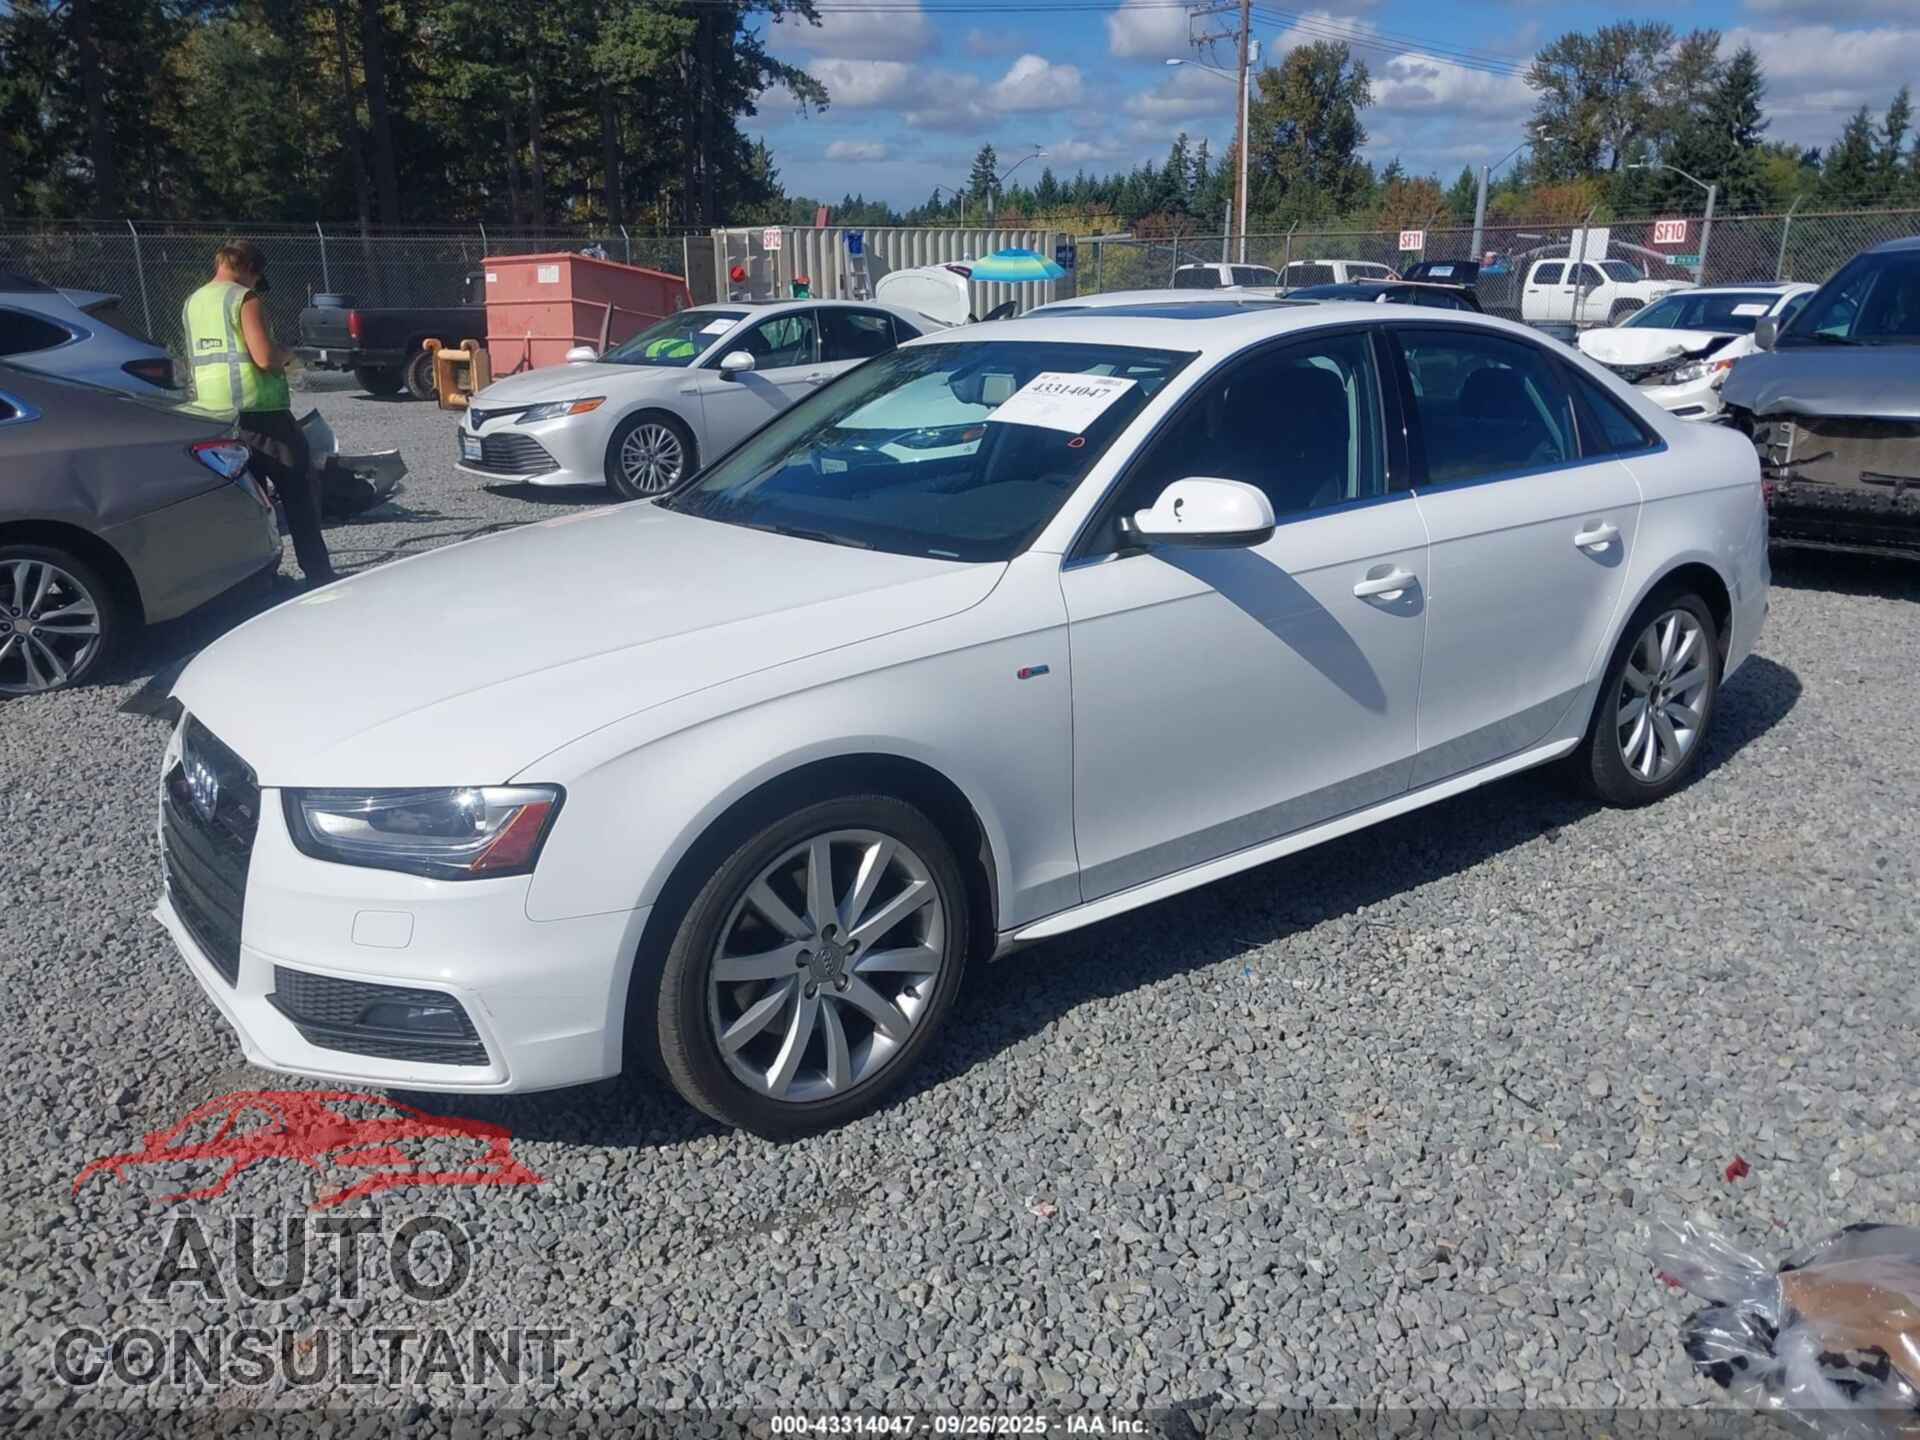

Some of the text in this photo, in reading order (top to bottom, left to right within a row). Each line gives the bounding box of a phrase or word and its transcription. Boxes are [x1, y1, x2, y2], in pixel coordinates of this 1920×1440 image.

[1656, 222, 1685, 241] SF10
[1401, 232, 1421, 248] SF11
[1032, 383, 1110, 398] 43314047
